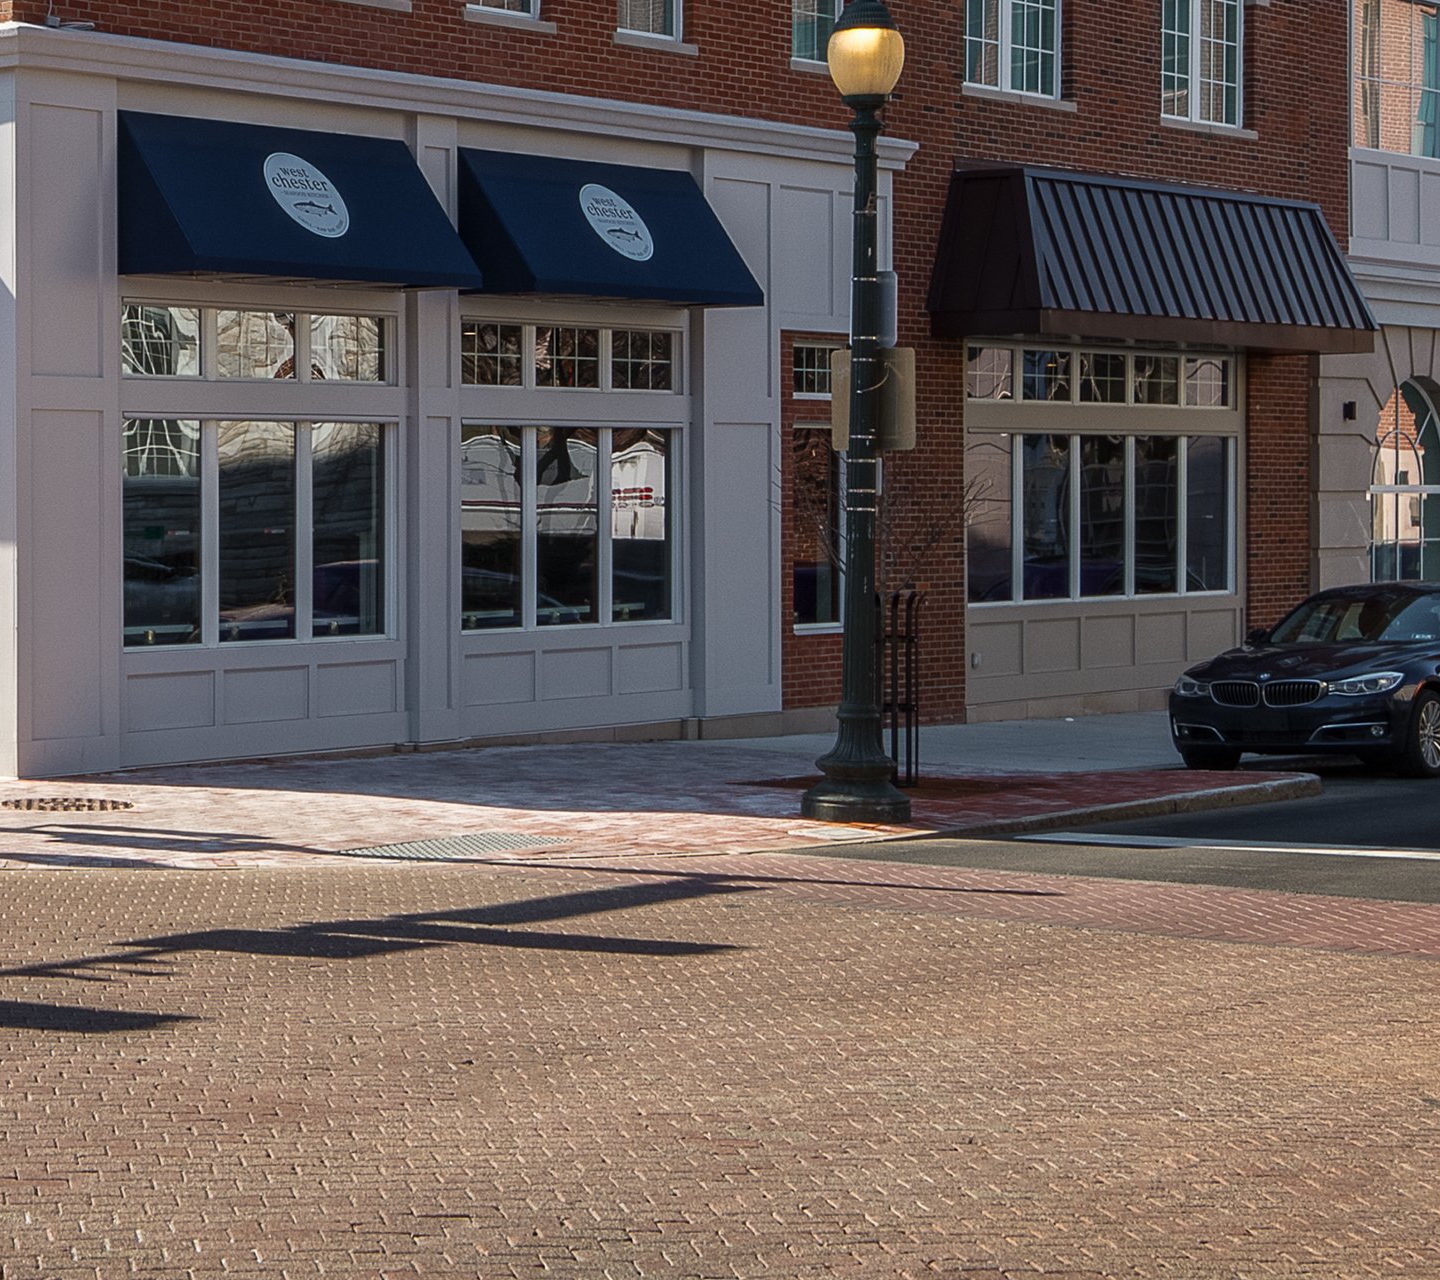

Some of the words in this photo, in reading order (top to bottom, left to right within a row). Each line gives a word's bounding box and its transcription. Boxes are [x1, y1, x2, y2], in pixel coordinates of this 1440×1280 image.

[279, 167, 309, 178] west
[271, 172, 329, 191] chester
[591, 197, 617, 208] west
[586, 202, 634, 219] chester
